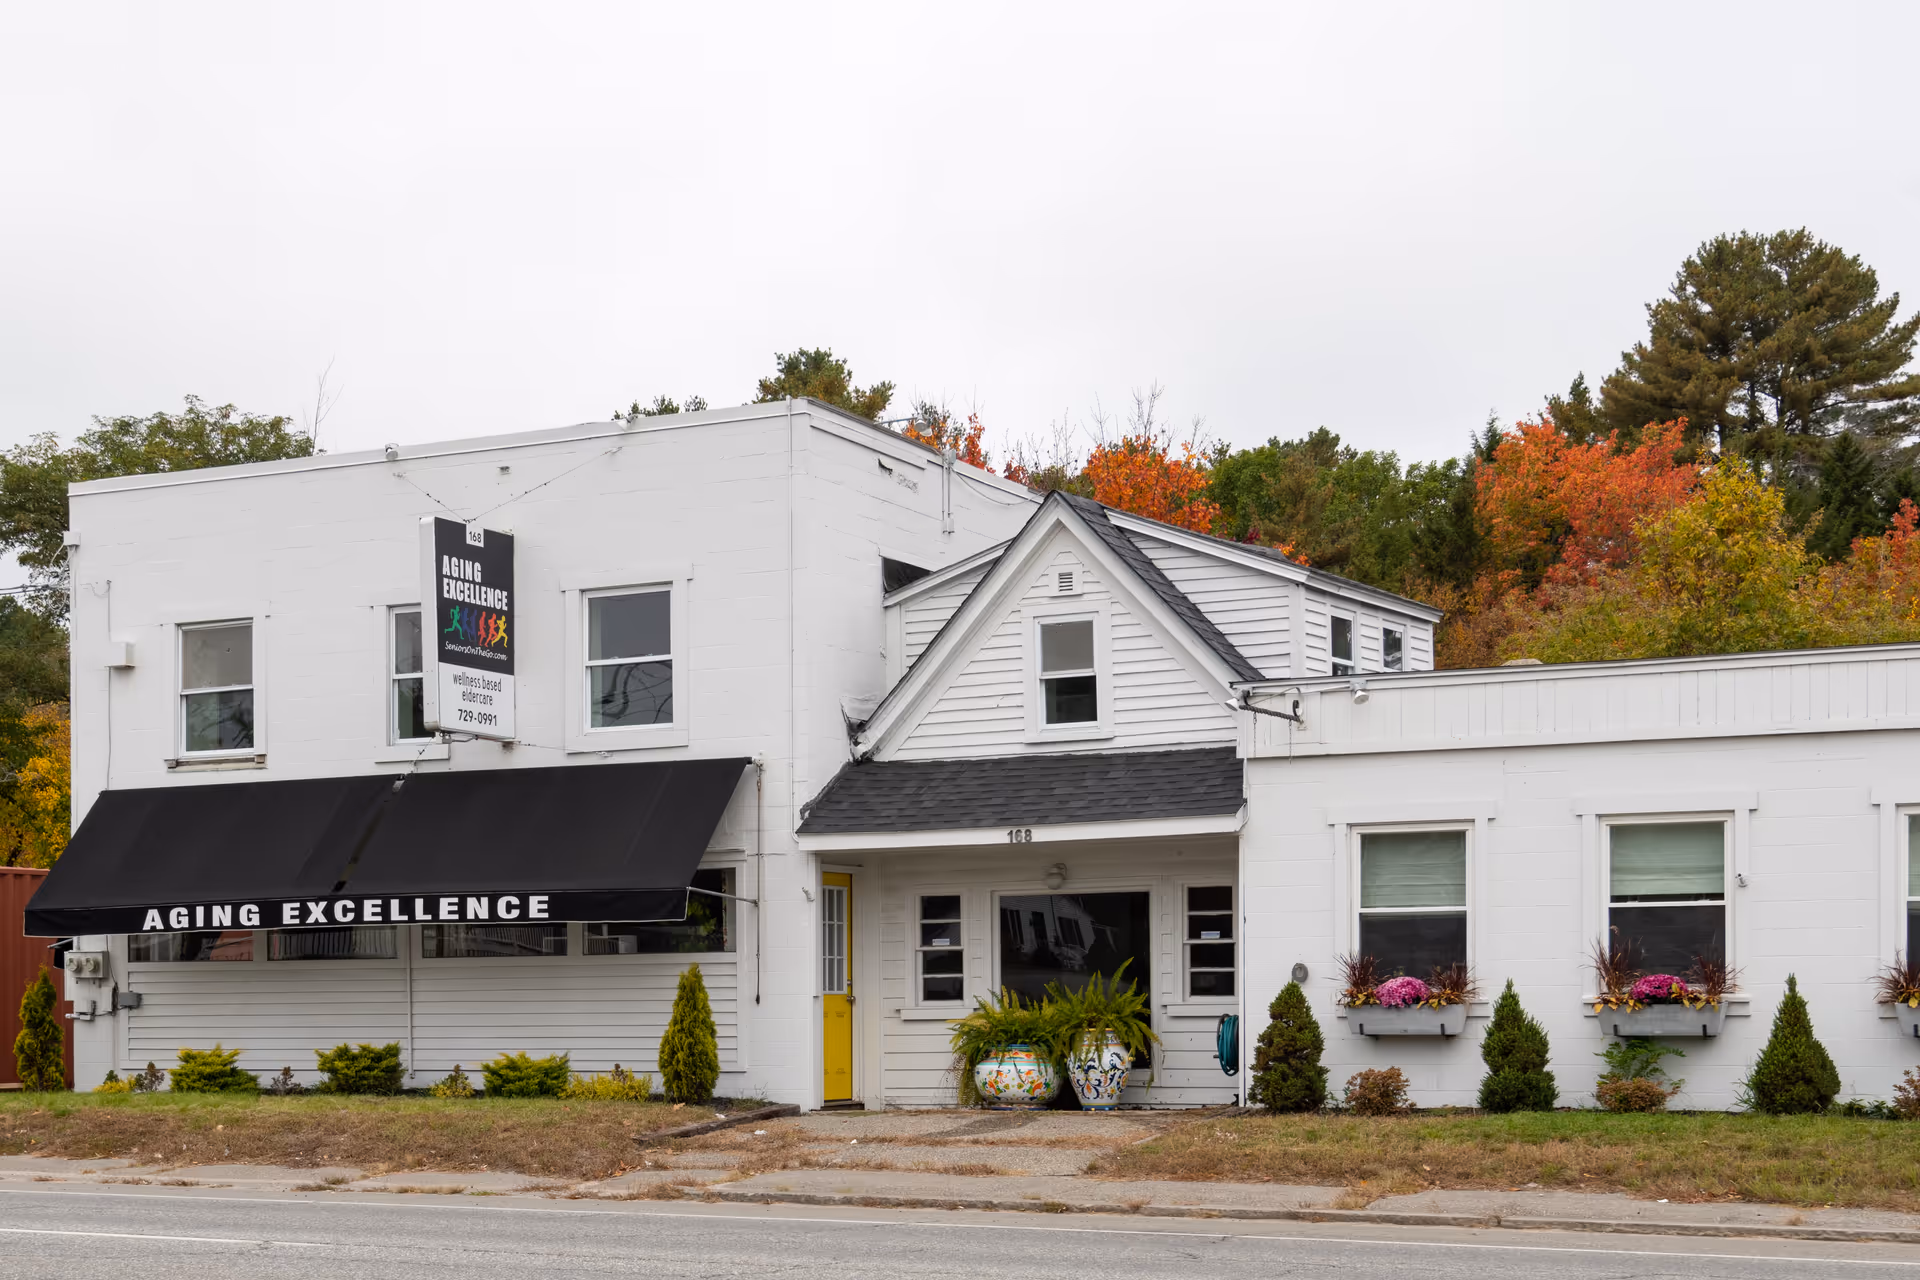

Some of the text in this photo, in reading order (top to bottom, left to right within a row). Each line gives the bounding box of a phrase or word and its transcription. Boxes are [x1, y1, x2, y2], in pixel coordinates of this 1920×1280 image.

[468, 531, 482, 543] 168
[442, 555, 482, 583] AGING
[442, 577, 508, 611] EXCELLENCE
[445, 641, 508, 661] SeniorsOnTheGo.com
[453, 672, 502, 692] wellness based
[462, 688, 493, 706] eldercare
[458, 709, 497, 727] 729-0991
[1007, 829, 1032, 843] 168
[142, 895, 550, 931] AGING EXCELLENCE
